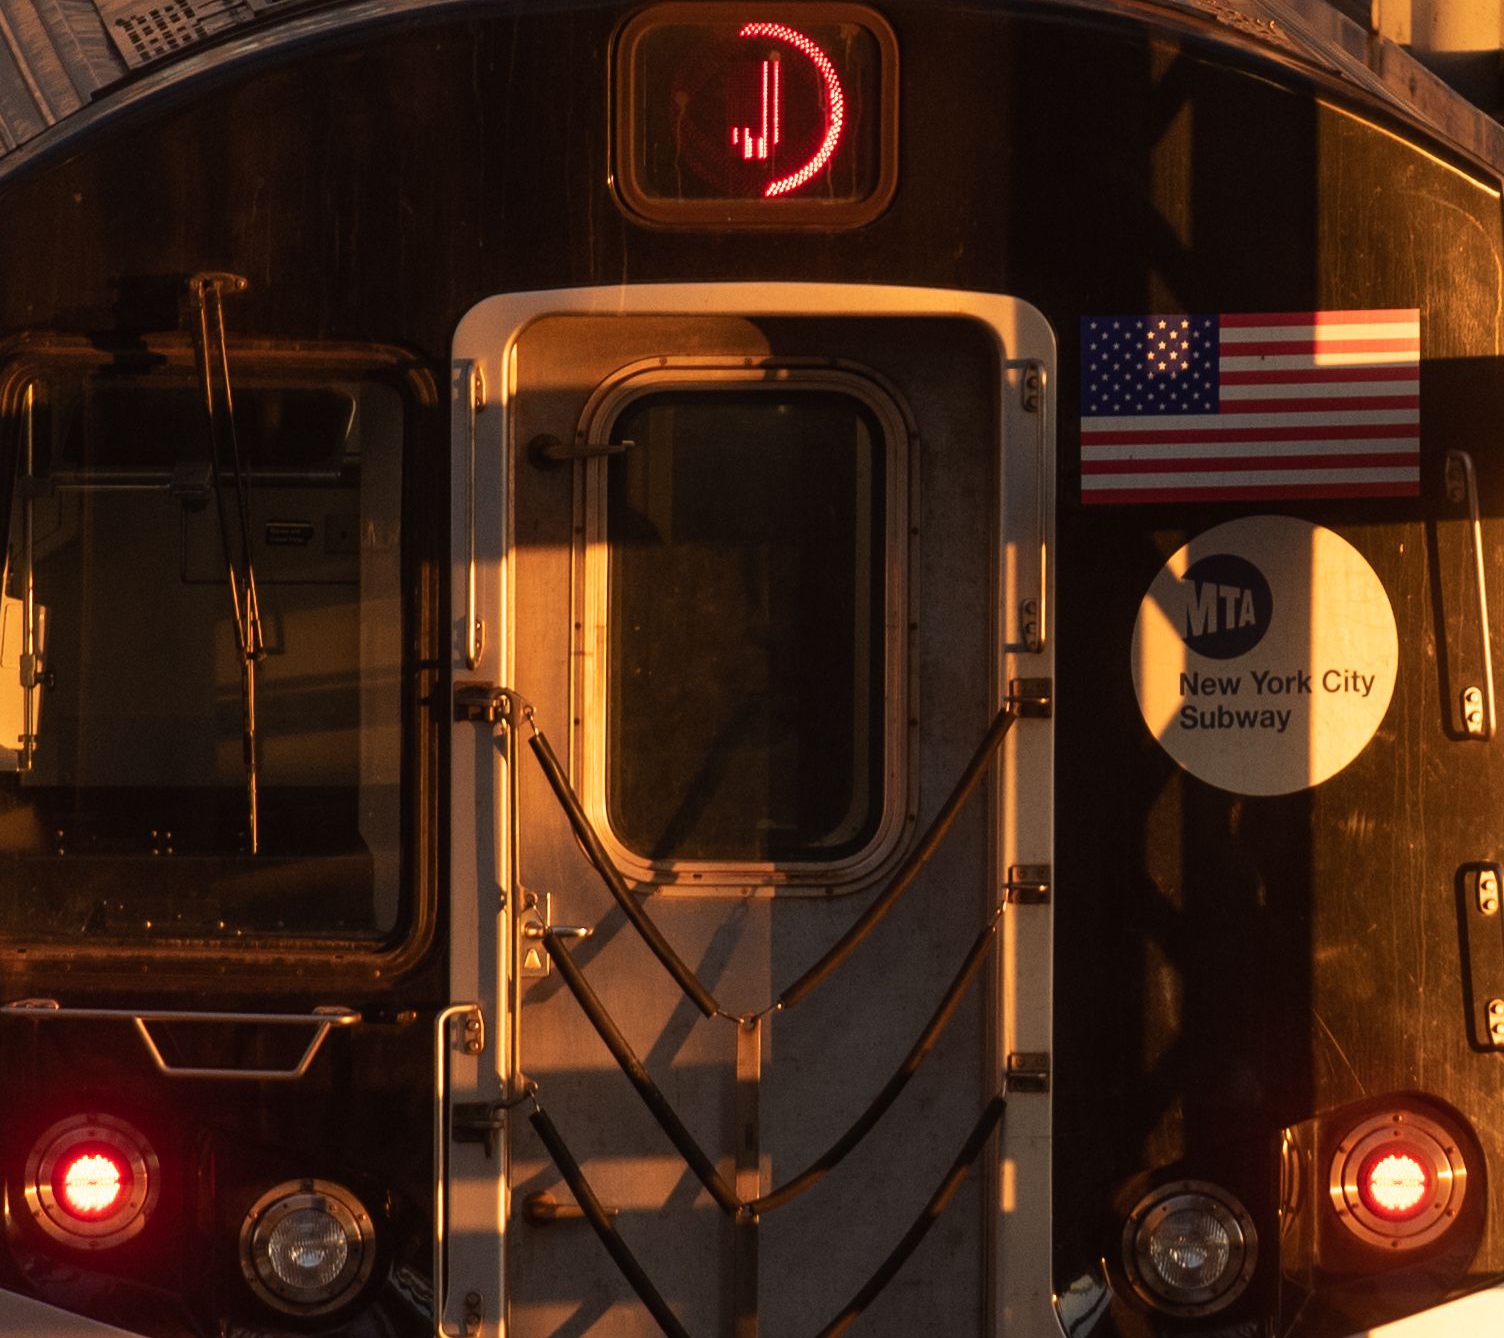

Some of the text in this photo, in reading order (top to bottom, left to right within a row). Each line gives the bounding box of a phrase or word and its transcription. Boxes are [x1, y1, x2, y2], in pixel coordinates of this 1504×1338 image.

[731, 59, 780, 160] J
[1181, 577, 1257, 640] MTA
[1179, 669, 1375, 697] New York City
[1179, 705, 1292, 733] Subway
